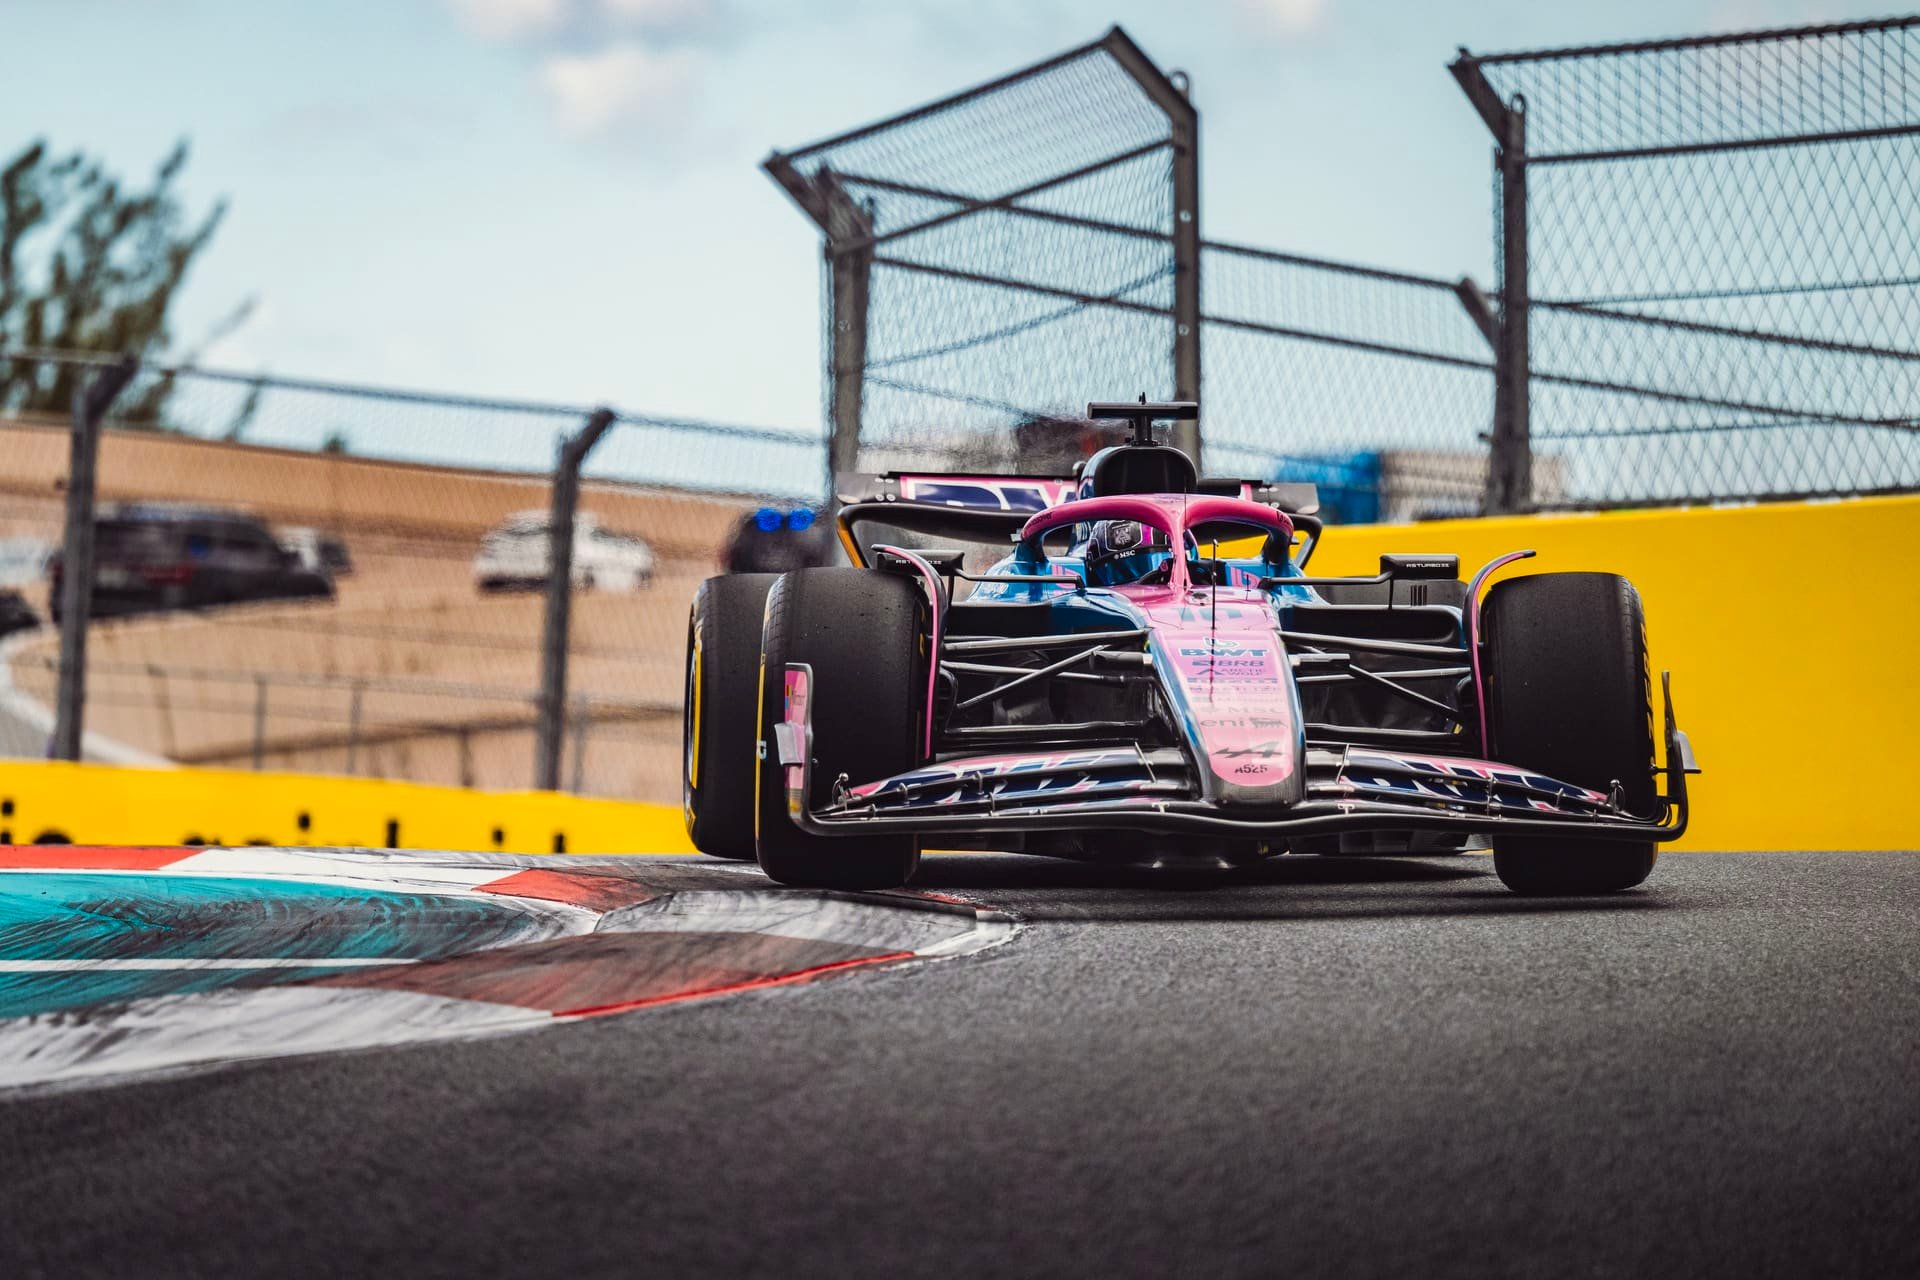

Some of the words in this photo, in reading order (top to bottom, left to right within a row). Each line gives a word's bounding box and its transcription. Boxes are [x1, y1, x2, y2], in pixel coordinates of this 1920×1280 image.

[1120, 550, 1136, 558] MSC
[1180, 648, 1268, 657] BWT
[1200, 718, 1244, 727] eni
[1234, 764, 1269, 774] A525
